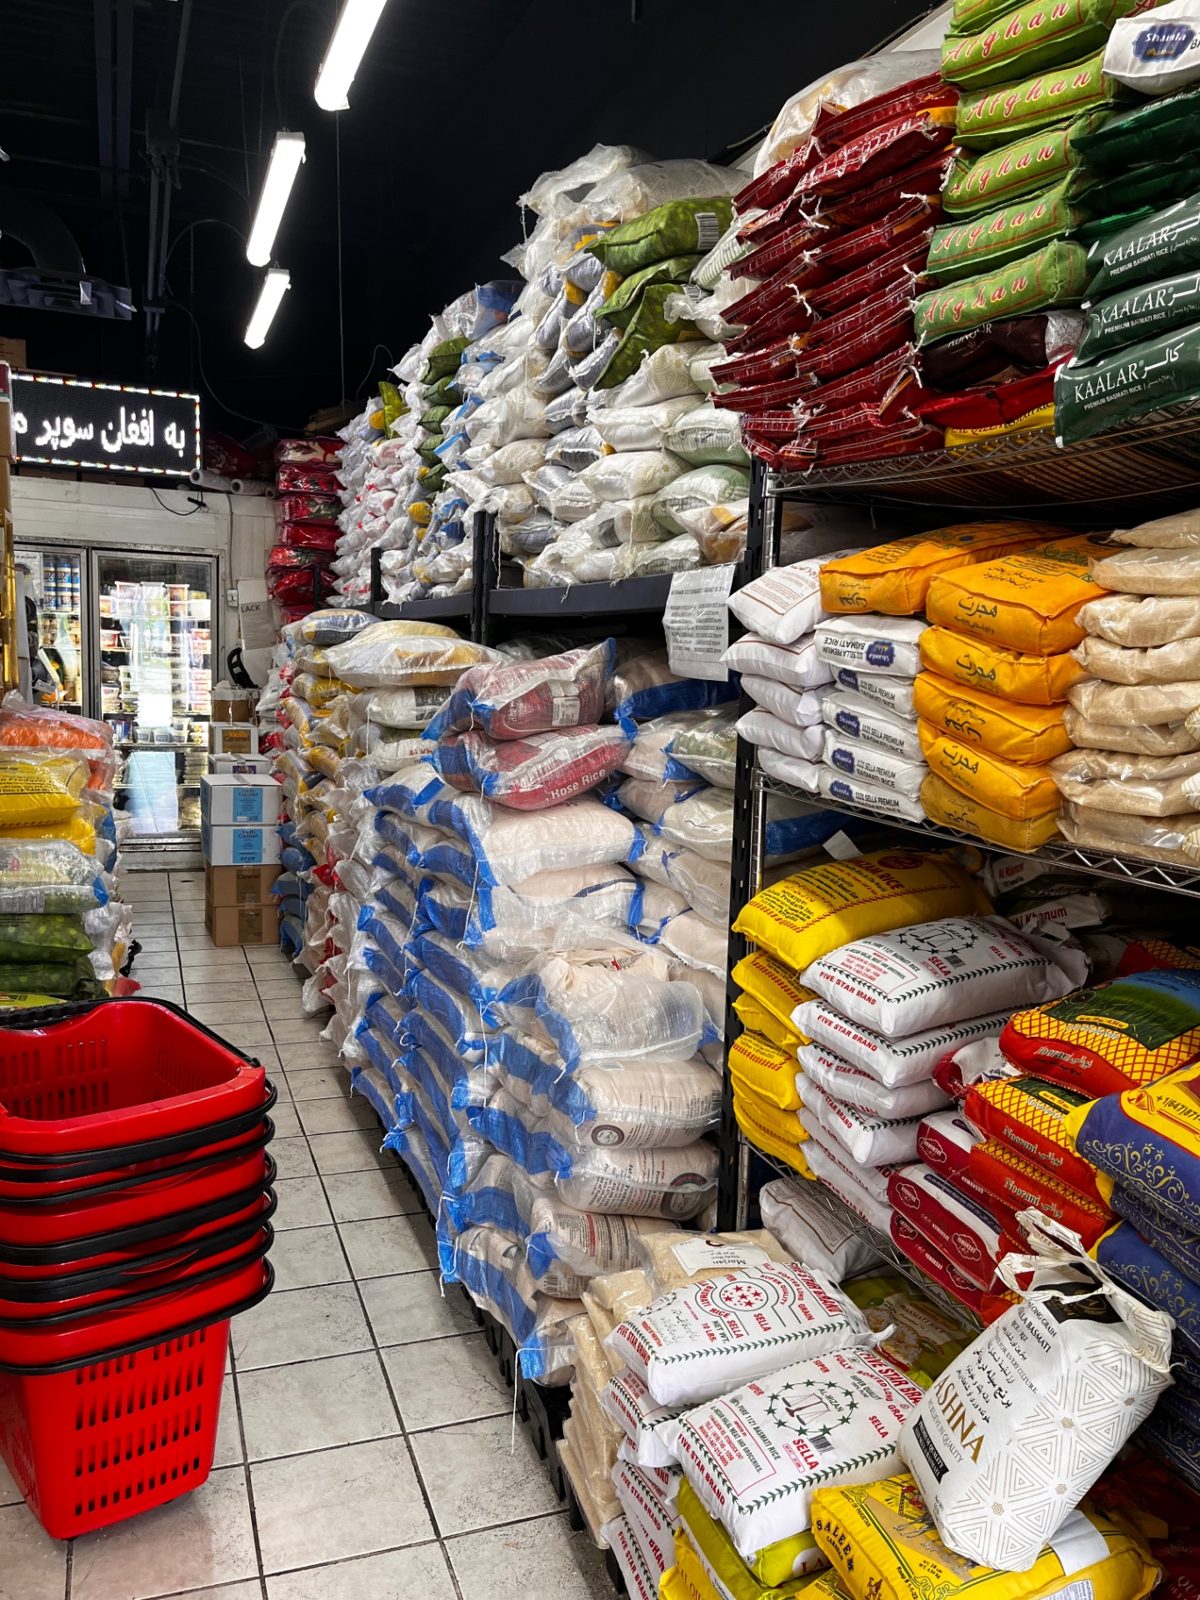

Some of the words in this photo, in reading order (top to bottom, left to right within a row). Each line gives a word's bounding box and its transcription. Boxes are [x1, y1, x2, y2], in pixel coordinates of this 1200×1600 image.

[942, 3, 1069, 66] Afghan
[966, 70, 1092, 122] Afghan
[933, 203, 1047, 254] Afghan
[1104, 226, 1169, 268] KAALAR
[1156, 247, 1169, 257] RICE
[919, 274, 1028, 327] Afghan
[1101, 288, 1166, 324] KAALAR
[1153, 311, 1167, 320] RICE
[1074, 362, 1139, 403] KAALAR
[1129, 385, 1142, 394] RICE
[101, 406, 154, 453] افغان
[241, 604, 261, 613] LACK
[823, 637, 839, 648] RICE
[882, 730, 905, 746] PREMIUM
[582, 767, 607, 790] Rice
[877, 795, 899, 806] PREMIUM
[881, 874, 905, 895] RICE
[988, 945, 1006, 960] SELLA
[928, 955, 951, 977] SELLA
[819, 971, 834, 983] FIVE
[836, 979, 855, 995] STAR
[856, 990, 877, 1006] BRAND
[817, 1014, 834, 1029] FIVE
[834, 1022, 851, 1038] STAR
[852, 1033, 878, 1052] BRAND
[818, 1056, 832, 1069] FIV
[835, 1065, 851, 1074] STAR
[825, 1096, 837, 1112] STAR
[836, 1108, 853, 1130] BRAND
[1002, 1125, 1039, 1154] Noorani
[1003, 1176, 1041, 1206] Noorani
[760, 1274, 782, 1286] SUPER
[709, 1306, 730, 1319] RICE
[726, 1319, 744, 1339] SELLA
[753, 1312, 772, 1333] SELLA
[798, 1303, 815, 1321] GRAIN
[704, 1328, 718, 1343] LBS.
[711, 1319, 723, 1332] NET
[717, 1330, 730, 1344] WT.
[1025, 1322, 1052, 1352] BASMATI
[1039, 1317, 1058, 1337] GRAIN
[616, 1324, 629, 1337] FIVE
[626, 1330, 638, 1350] STAR
[636, 1340, 651, 1366] BRAND
[813, 1359, 830, 1374] SUPER
[833, 1353, 854, 1370] FULLY
[747, 1382, 765, 1397] SUPER
[850, 1374, 865, 1387] SUPER
[863, 1385, 883, 1400] QUALITY
[856, 1370, 888, 1388] SORTED
[859, 1350, 886, 1371] FIVE
[879, 1367, 908, 1387] STAR
[900, 1386, 923, 1406] BRA
[883, 1386, 894, 1402] LONG
[868, 1415, 889, 1439] SELLA
[888, 1404, 907, 1426] GRAI
[934, 1374, 985, 1465] ASHNA
[728, 1426, 741, 1440] MEAT
[736, 1437, 746, 1449] AND
[736, 1404, 748, 1417] PURE
[752, 1424, 771, 1447] BASMATI
[767, 1444, 781, 1461] RICE
[792, 1438, 820, 1470] SELLA
[925, 1443, 946, 1468] QUALITY
[940, 1433, 964, 1463] QUALITY
[678, 1433, 691, 1452] FIVE
[690, 1450, 706, 1475] STAR
[705, 1471, 725, 1506] BRAND
[621, 1471, 631, 1489] FIVE
[630, 1485, 644, 1505] STAR
[643, 1501, 661, 1531] BRAND
[856, 1508, 871, 1527] PAKISTAN
[618, 1531, 626, 1551] FIVE
[625, 1550, 637, 1574] STAR
